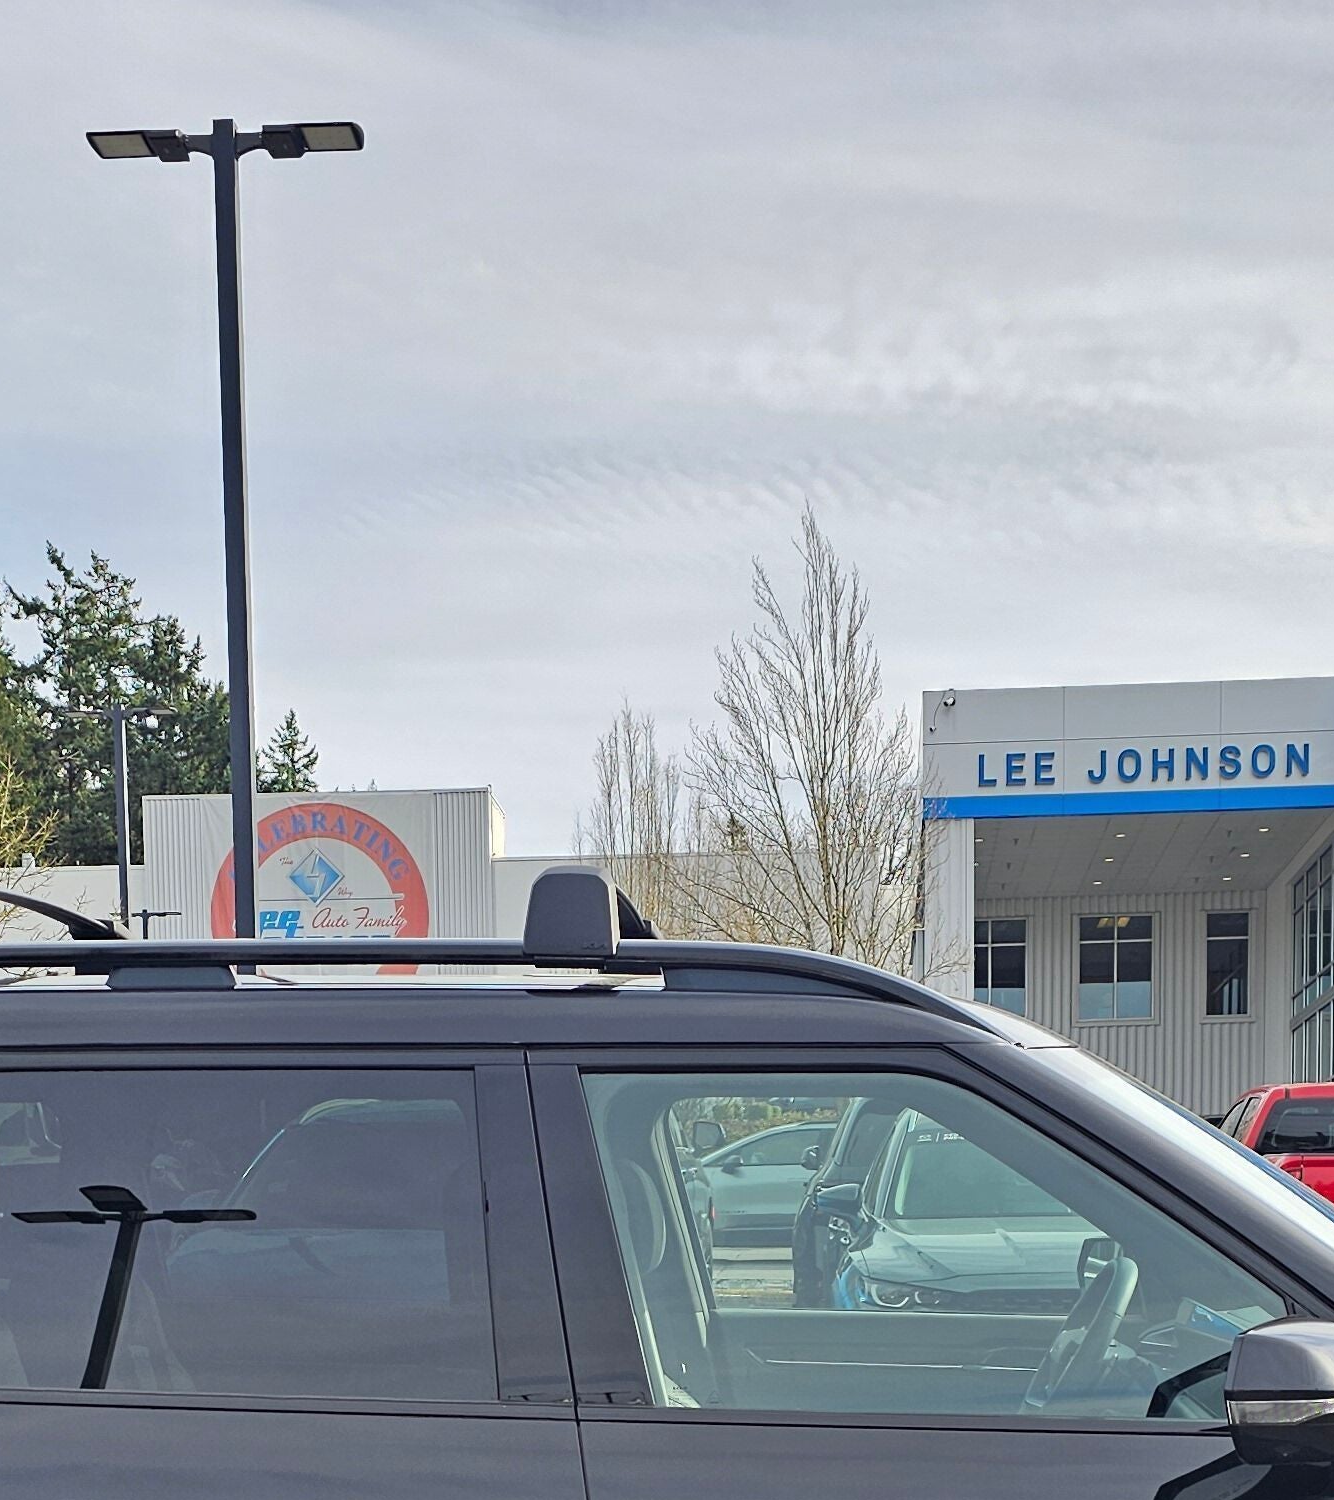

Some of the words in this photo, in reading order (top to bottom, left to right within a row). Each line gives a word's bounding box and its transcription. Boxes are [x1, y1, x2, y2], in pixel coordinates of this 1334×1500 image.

[978, 752, 1055, 787] LEE
[1087, 743, 1310, 784] JOHNSON
[312, 907, 349, 929] Auto
[353, 905, 408, 937] Family
